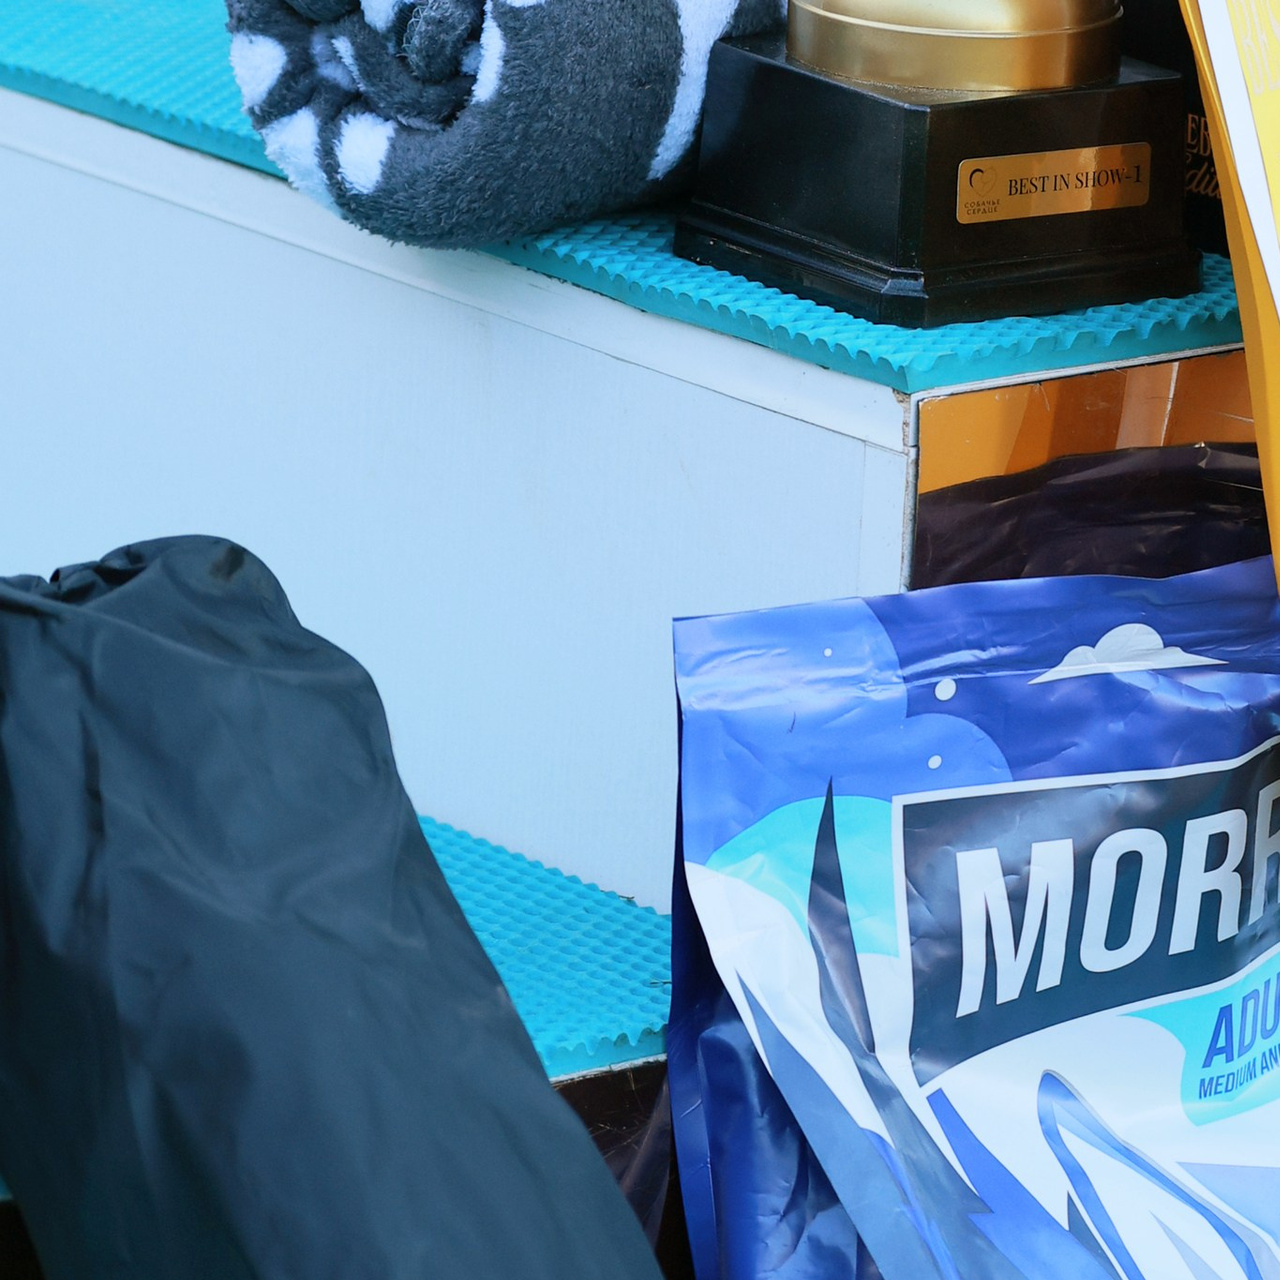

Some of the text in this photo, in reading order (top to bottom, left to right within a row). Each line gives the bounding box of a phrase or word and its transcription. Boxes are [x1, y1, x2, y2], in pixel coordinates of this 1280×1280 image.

[1008, 164, 1142, 197] BEST IN SHOW-1
[964, 199, 1001, 209] СОБАЧЬЕ
[966, 206, 999, 216] СЕРДЦЕ
[1198, 1057, 1257, 1100] MEDIUM
